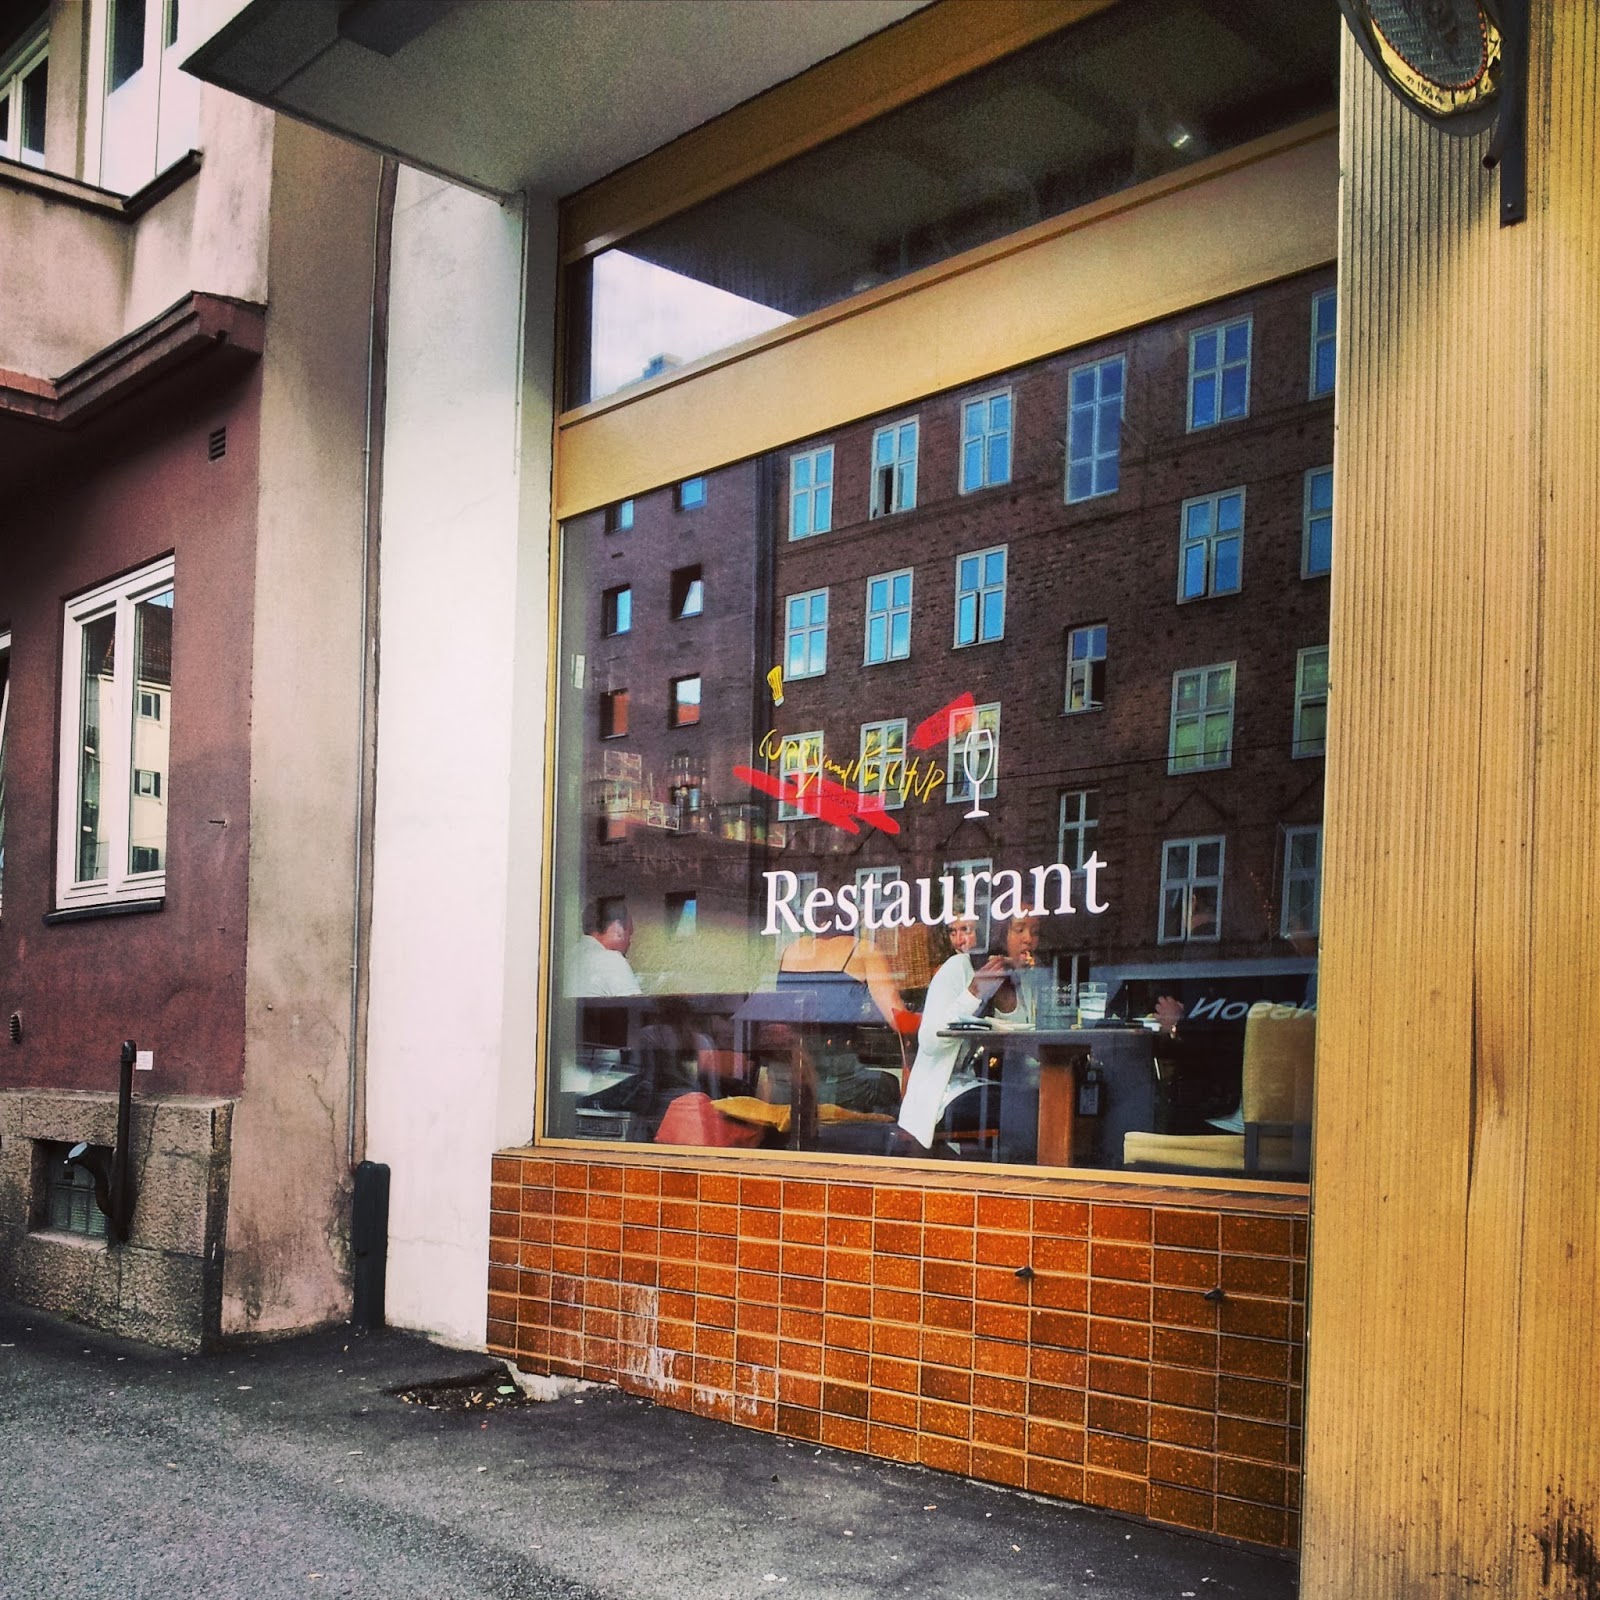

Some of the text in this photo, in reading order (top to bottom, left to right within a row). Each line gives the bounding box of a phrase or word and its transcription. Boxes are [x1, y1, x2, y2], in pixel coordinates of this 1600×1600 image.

[824, 758, 854, 792] and
[852, 734, 946, 803] KETCHUP
[761, 850, 1110, 936] Restaurant
